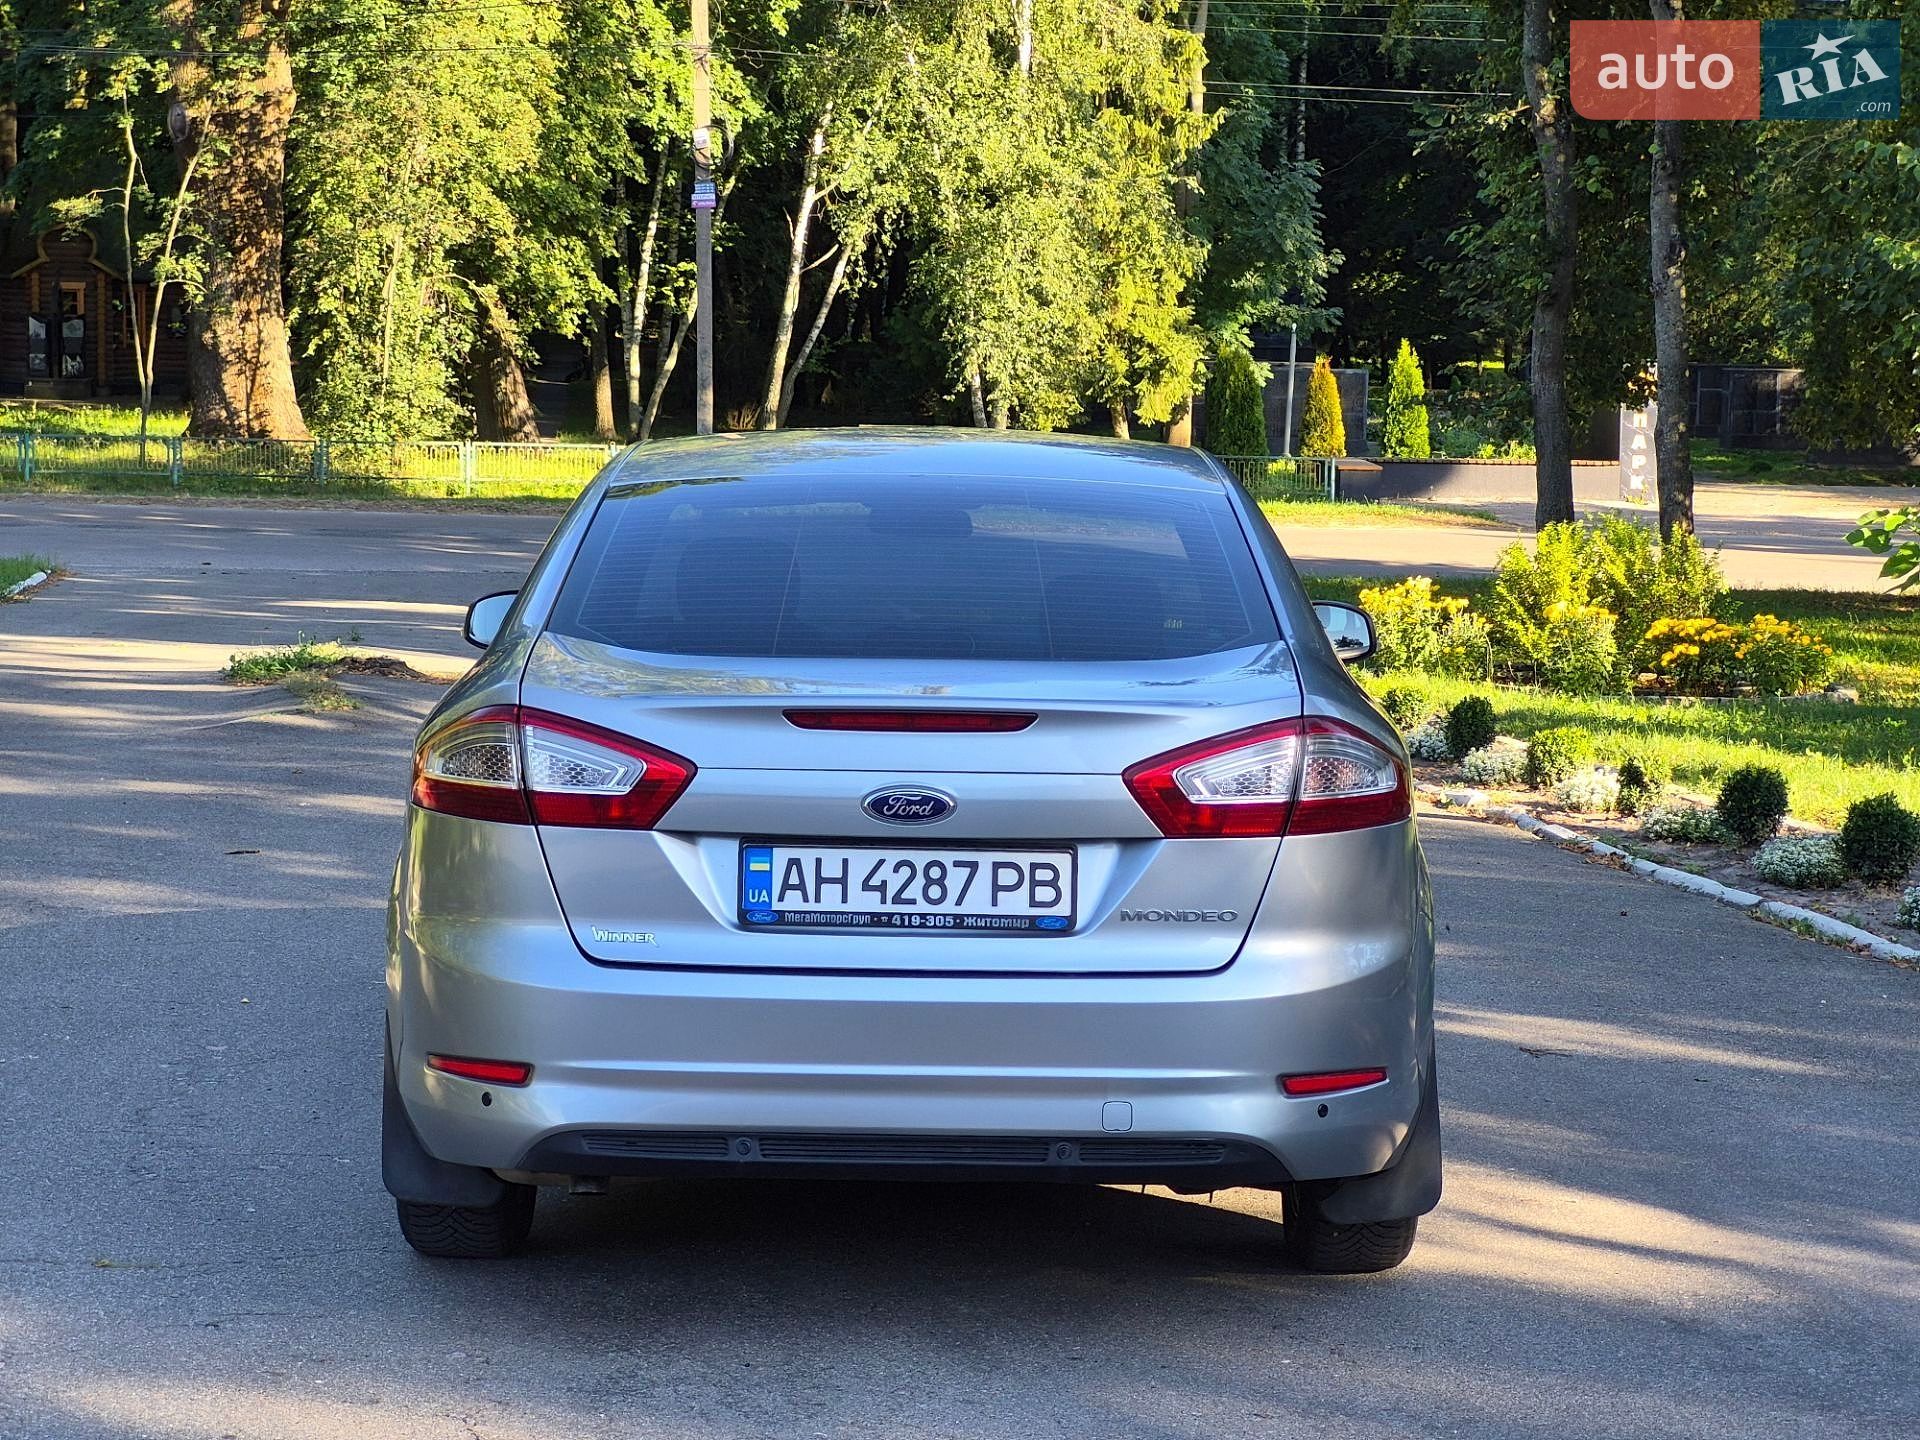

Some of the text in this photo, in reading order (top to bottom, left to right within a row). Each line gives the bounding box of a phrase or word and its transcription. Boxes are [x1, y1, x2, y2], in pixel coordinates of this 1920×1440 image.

[1630, 412, 1648, 490] ПАРК
[883, 795, 934, 816] Ford
[777, 857, 1063, 909] AH 4287 PB
[749, 888, 770, 903] UA
[891, 914, 954, 927] 419-305
[963, 916, 1030, 928] Житомир
[1120, 909, 1239, 922] MONDEO
